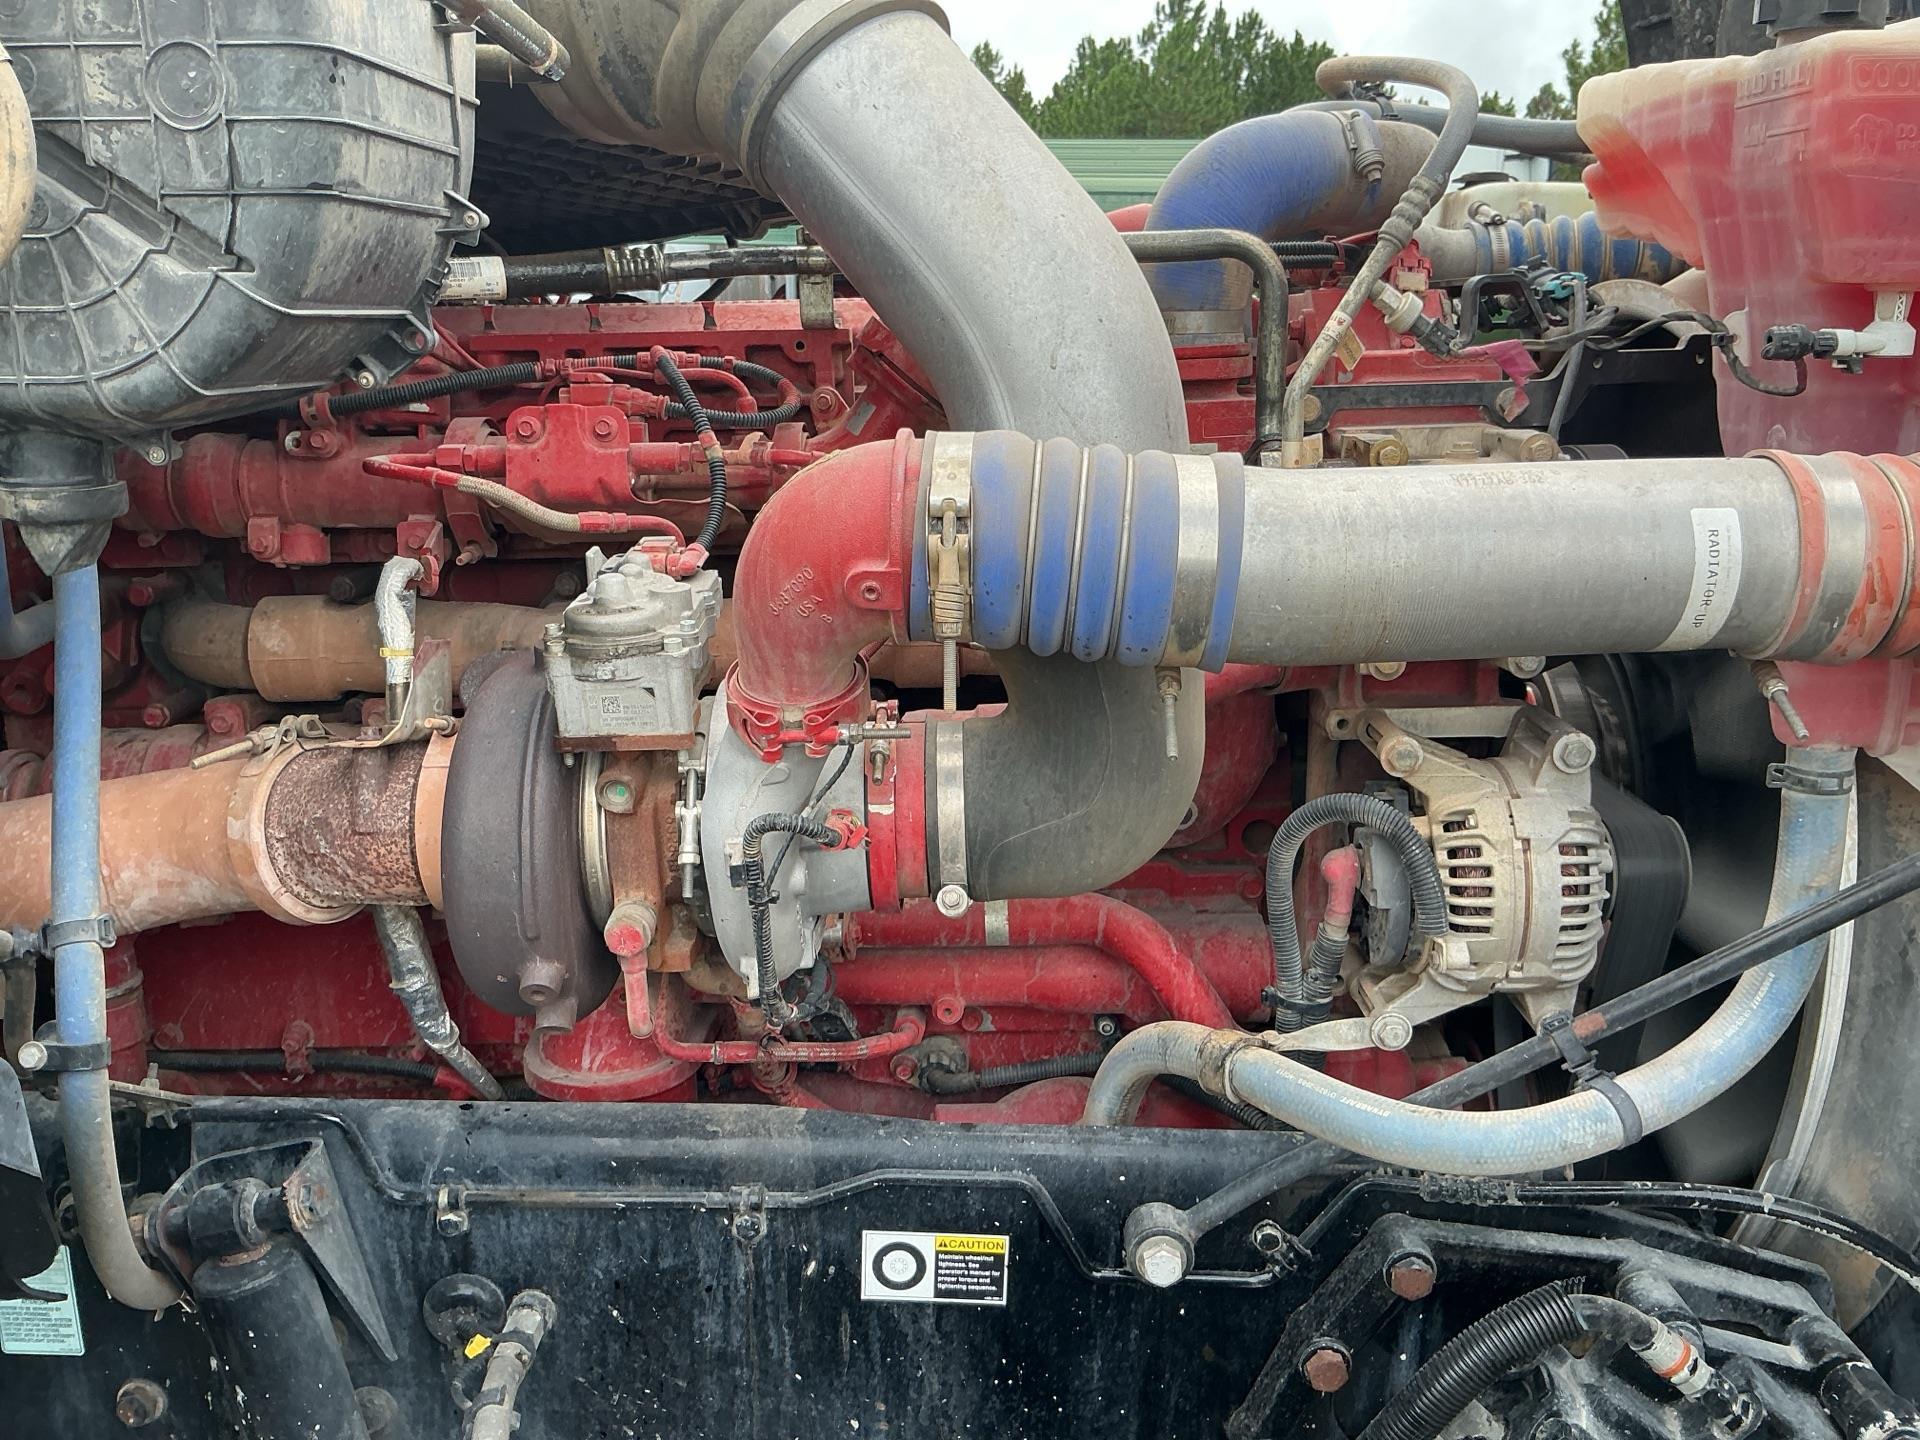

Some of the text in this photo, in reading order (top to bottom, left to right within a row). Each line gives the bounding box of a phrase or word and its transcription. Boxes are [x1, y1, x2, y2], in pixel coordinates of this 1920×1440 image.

[1692, 529, 1720, 629] RADIATOR UP
[797, 594, 823, 617] USA
[948, 1239, 1004, 1251] CAUTION
[938, 1253, 964, 1261] Maintain
[937, 1276, 957, 1284] proper
[958, 1277, 977, 1285] torque
